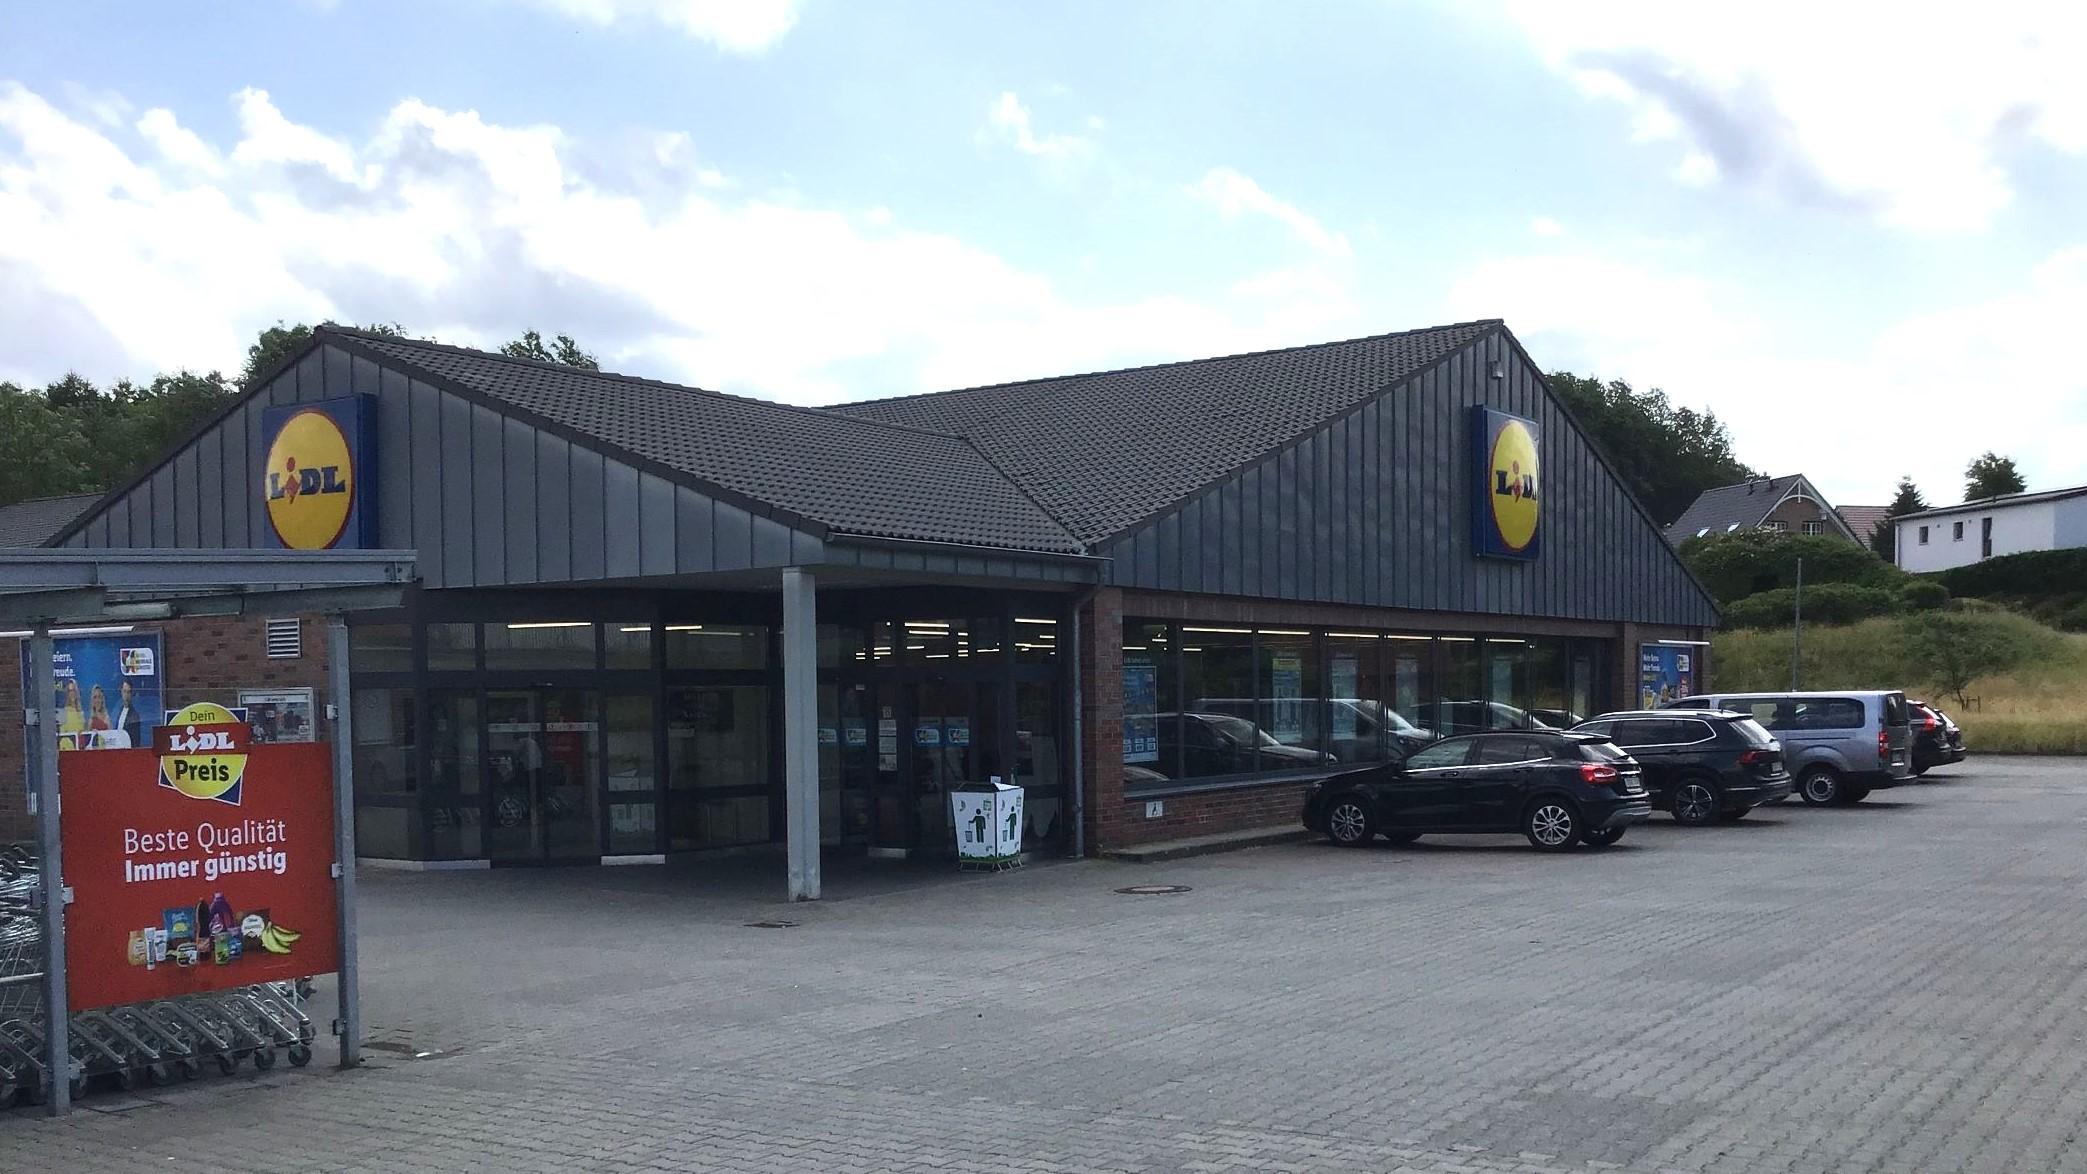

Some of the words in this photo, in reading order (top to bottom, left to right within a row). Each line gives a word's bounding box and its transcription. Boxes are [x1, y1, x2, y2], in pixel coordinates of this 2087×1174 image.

[52, 651, 73, 663] eiern.
[53, 666, 76, 677] reude.
[190, 710, 216, 721] Dein
[174, 757, 230, 781] Preis
[124, 828, 189, 854] Beste
[197, 819, 286, 853] Qualität
[125, 859, 200, 882] Immer
[204, 846, 287, 881] günstig
